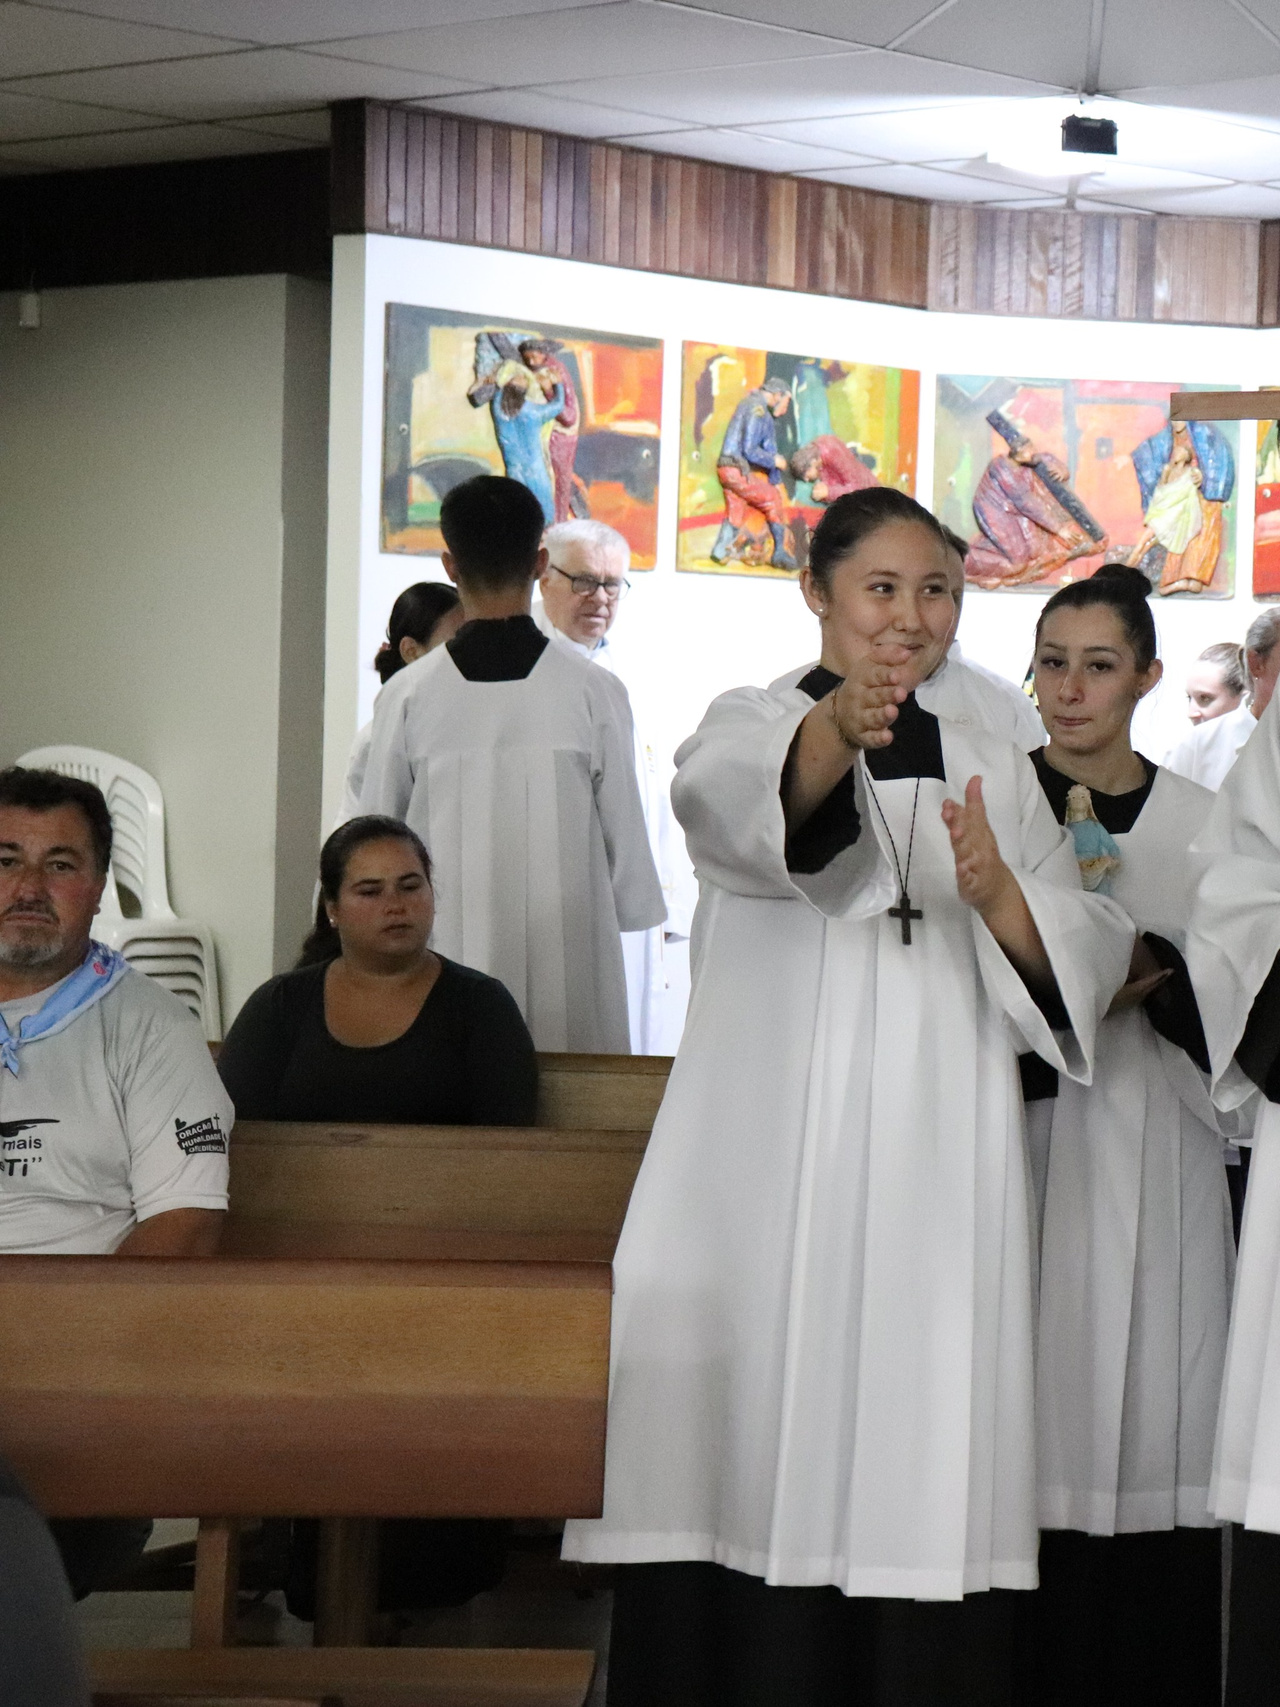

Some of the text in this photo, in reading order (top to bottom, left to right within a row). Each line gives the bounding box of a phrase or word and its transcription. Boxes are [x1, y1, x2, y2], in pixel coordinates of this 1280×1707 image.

[179, 1122, 212, 1139] ORAÇÃO
[3, 1136, 42, 1150] mais
[181, 1133, 222, 1148] HUMILDADE
